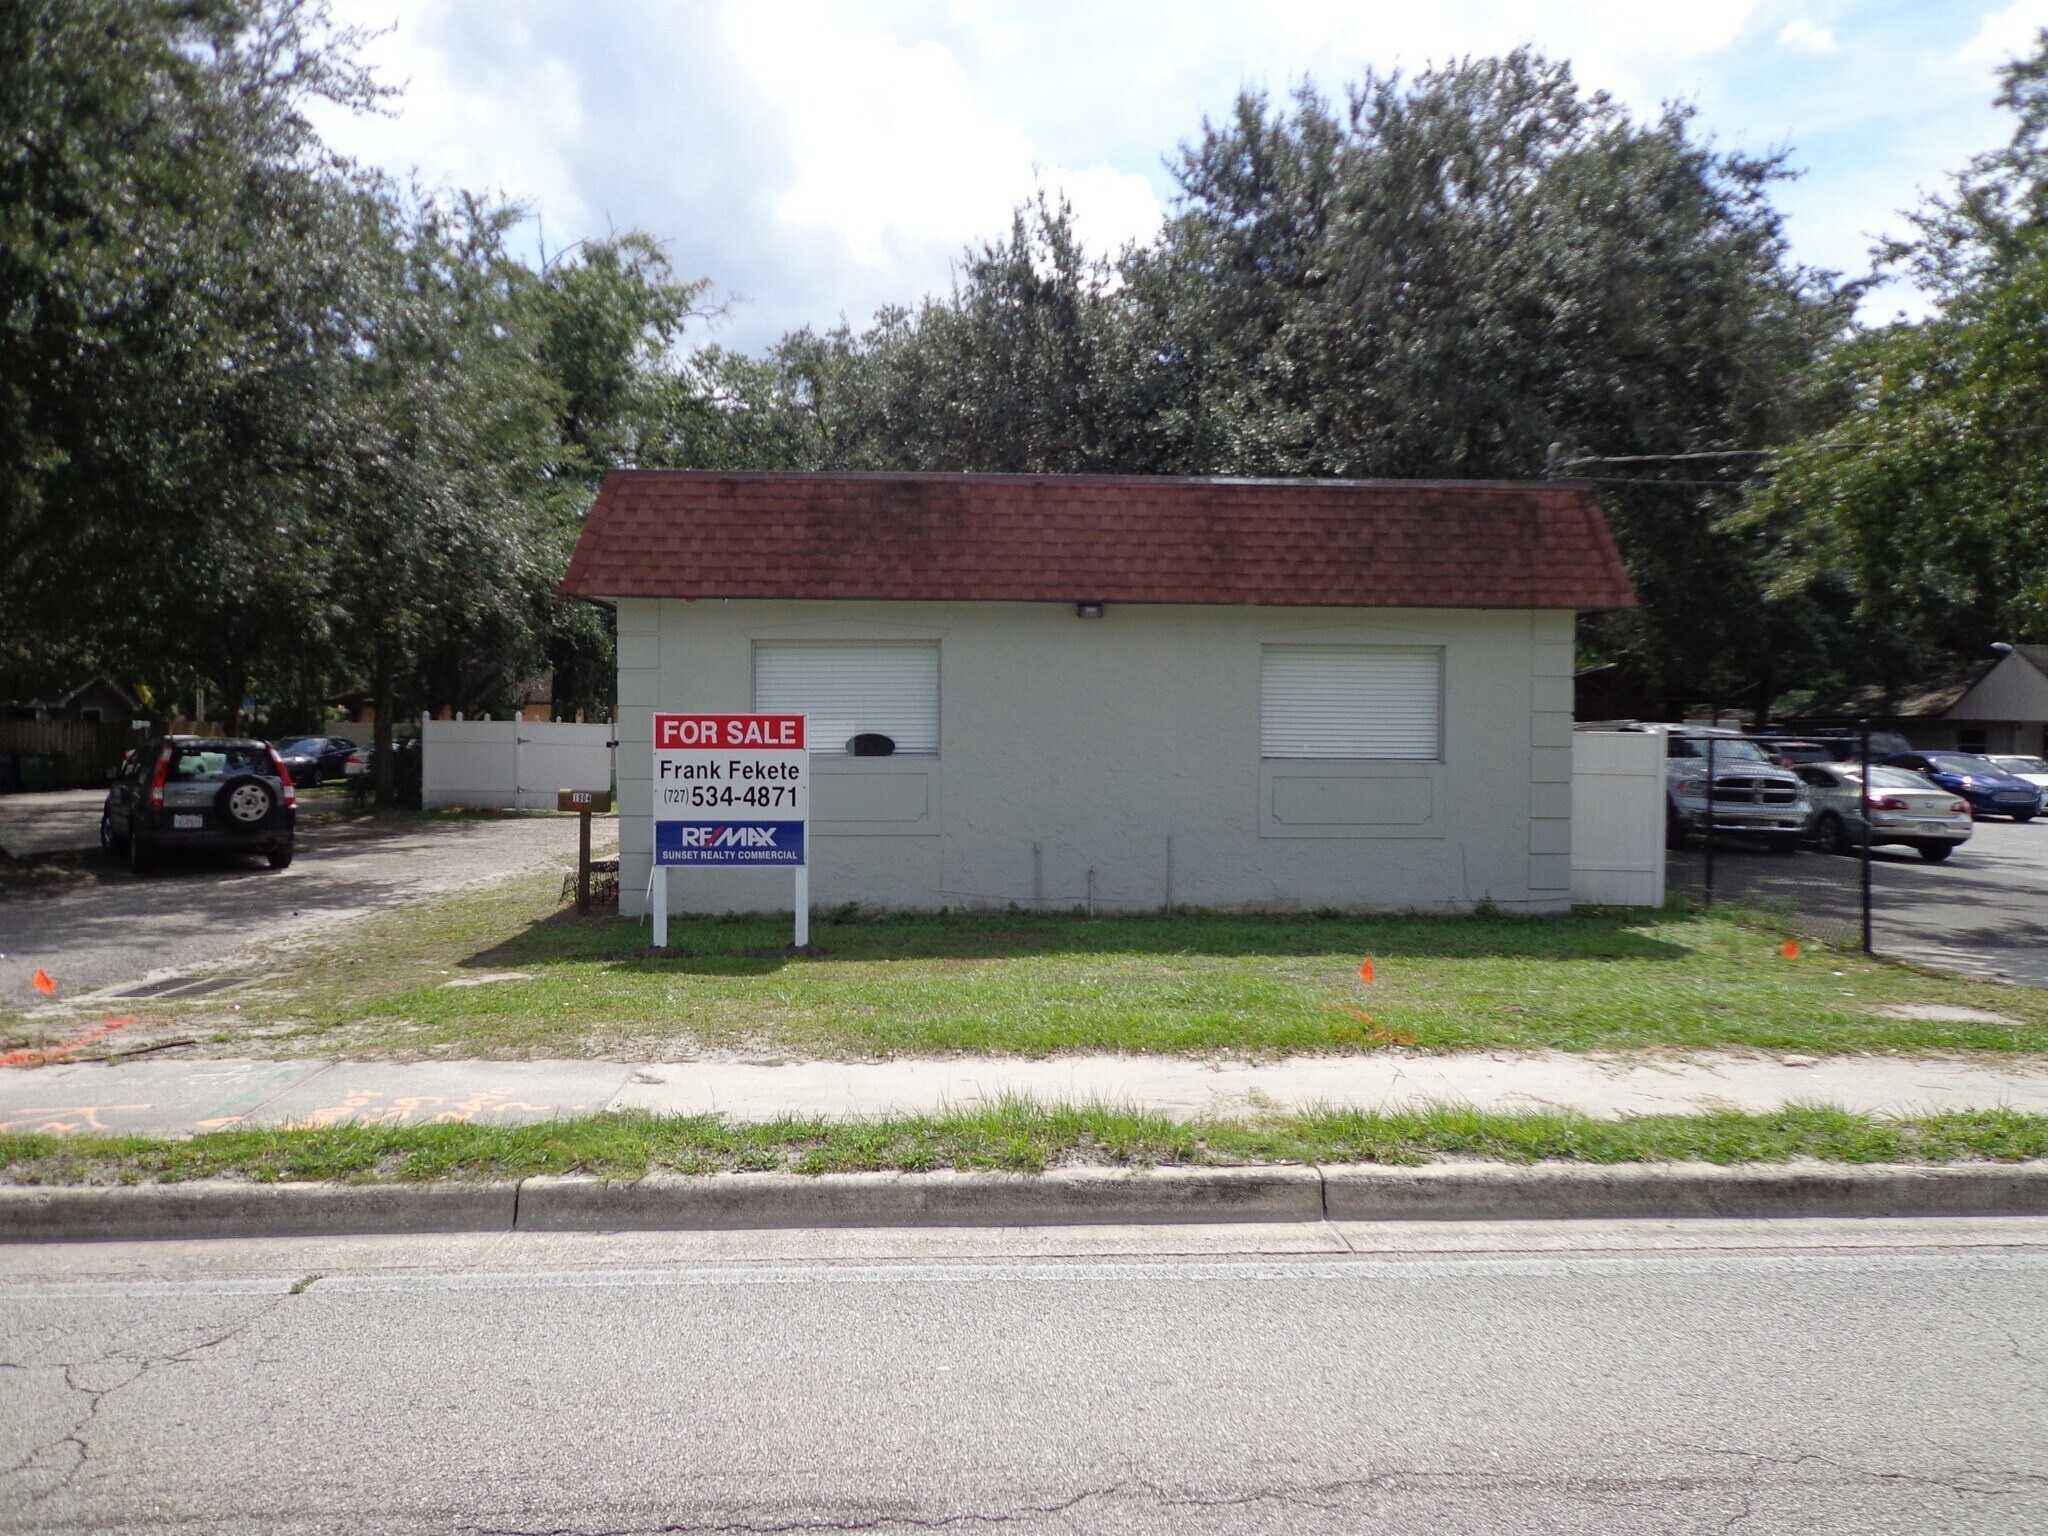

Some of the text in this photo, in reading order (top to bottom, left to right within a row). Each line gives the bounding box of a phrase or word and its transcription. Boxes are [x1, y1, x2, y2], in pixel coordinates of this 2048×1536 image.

[663, 721, 796, 744] FOR SALE
[660, 760, 800, 779] Frank Fekete
[664, 786, 797, 807] (727) 534-4871
[682, 826, 777, 848] RE/MAX
[662, 850, 798, 860] SUNSET REALTY COMMERCIAL
